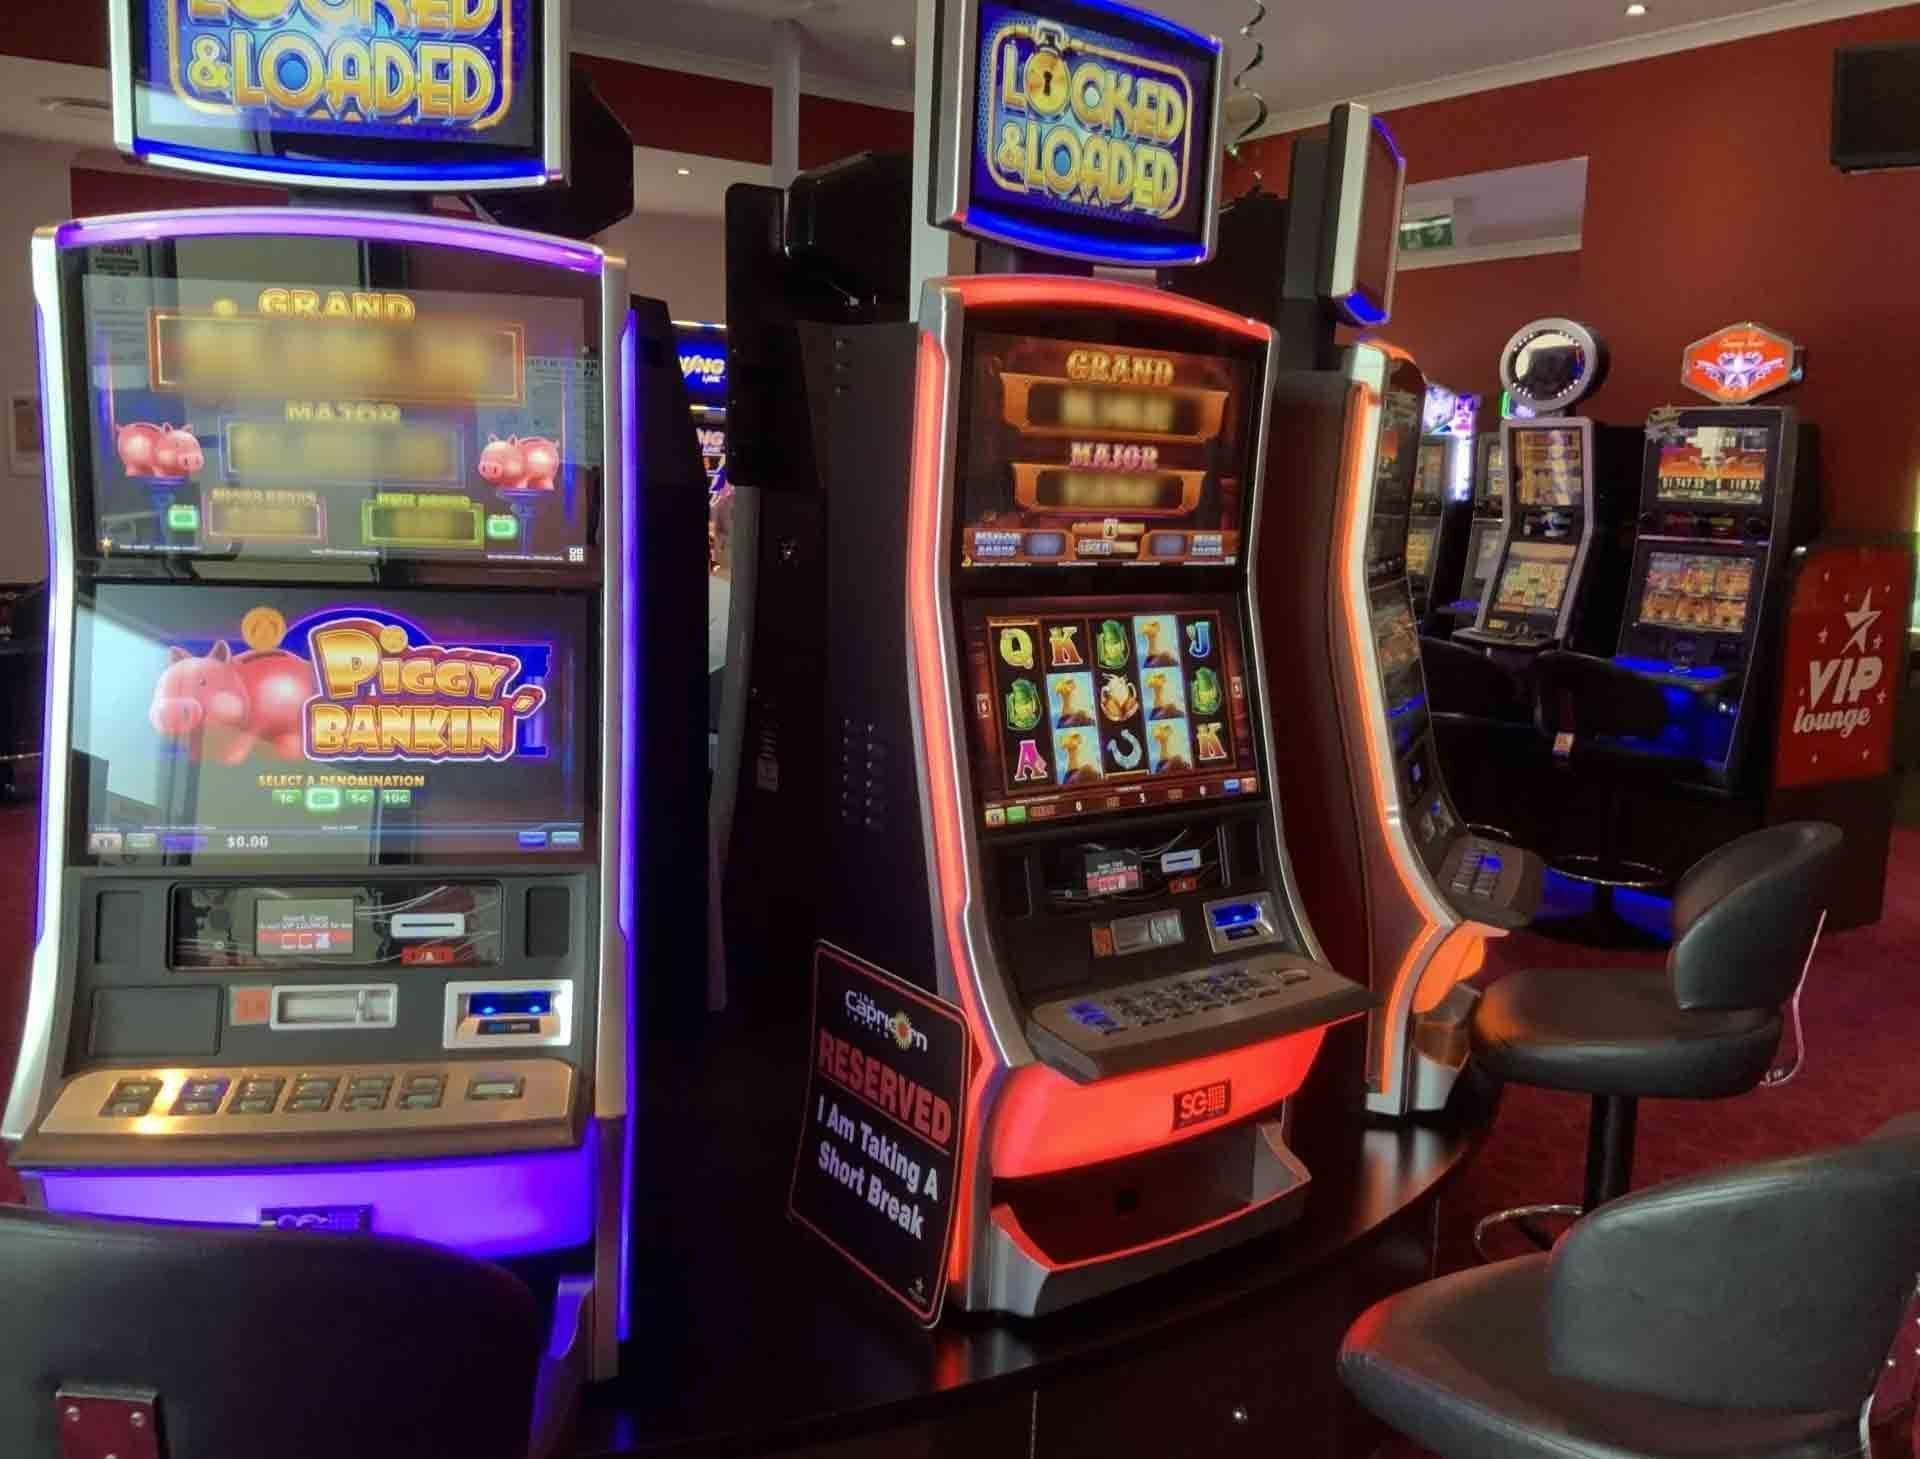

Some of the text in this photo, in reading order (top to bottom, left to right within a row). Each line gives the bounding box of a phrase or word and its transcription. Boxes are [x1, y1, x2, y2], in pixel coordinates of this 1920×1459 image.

[1002, 43, 1185, 144] LOCKED
[258, 287, 416, 321] GRAND
[1066, 349, 1175, 385] GRAND
[1070, 442, 1159, 472] MAJOR
[317, 628, 510, 701] PIGGY
[1000, 628, 1033, 669] Q
[1050, 626, 1084, 666] K
[1809, 655, 1883, 711] VIP
[1792, 704, 1872, 738] lounge
[1014, 722, 1227, 781] A K
[258, 775, 426, 788] SELECT A DENOMINATION
[226, 835, 270, 850] $0.00
[818, 1027, 953, 1146] RESERVED
[816, 1095, 940, 1202] I Am Taking A
[818, 1140, 923, 1241] Short Break
